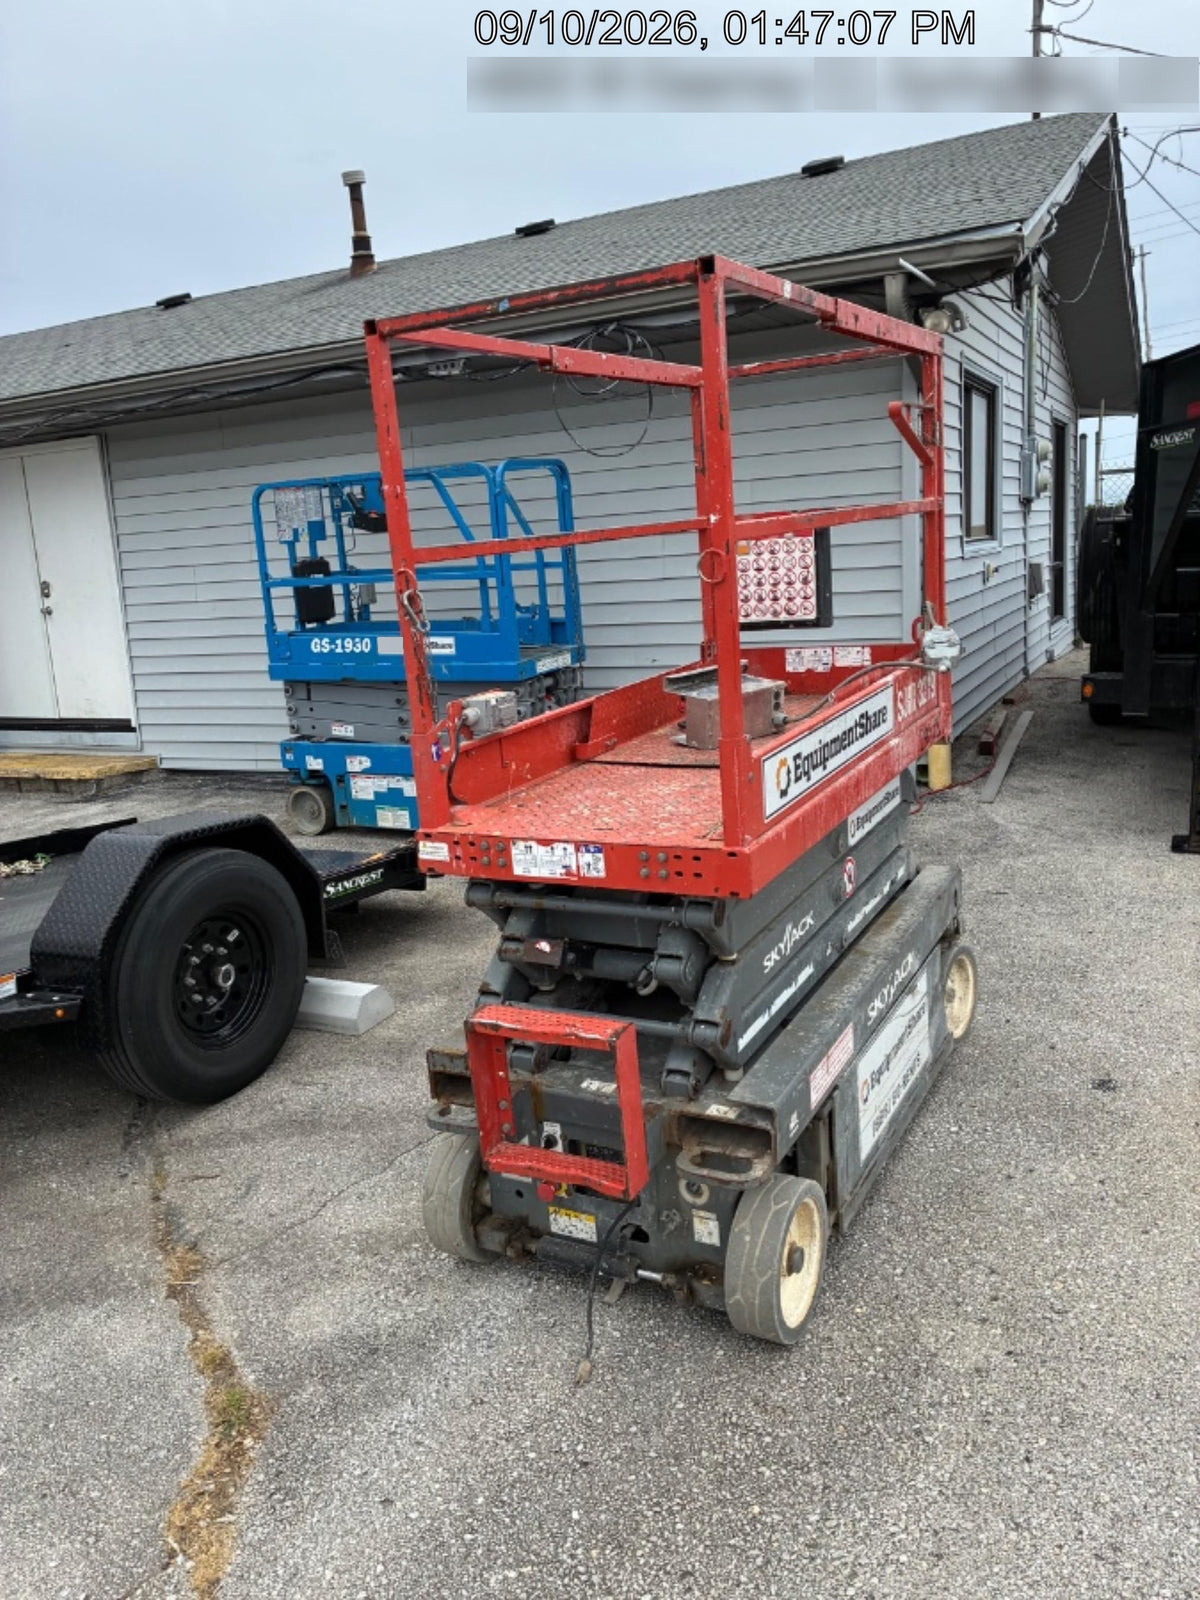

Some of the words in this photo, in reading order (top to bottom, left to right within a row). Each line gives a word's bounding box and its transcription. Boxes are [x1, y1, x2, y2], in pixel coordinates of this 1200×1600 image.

[310, 637, 371, 653] GS-1930
[792, 705, 887, 784] EquipmentShare
[762, 910, 816, 974] SKYJACK
